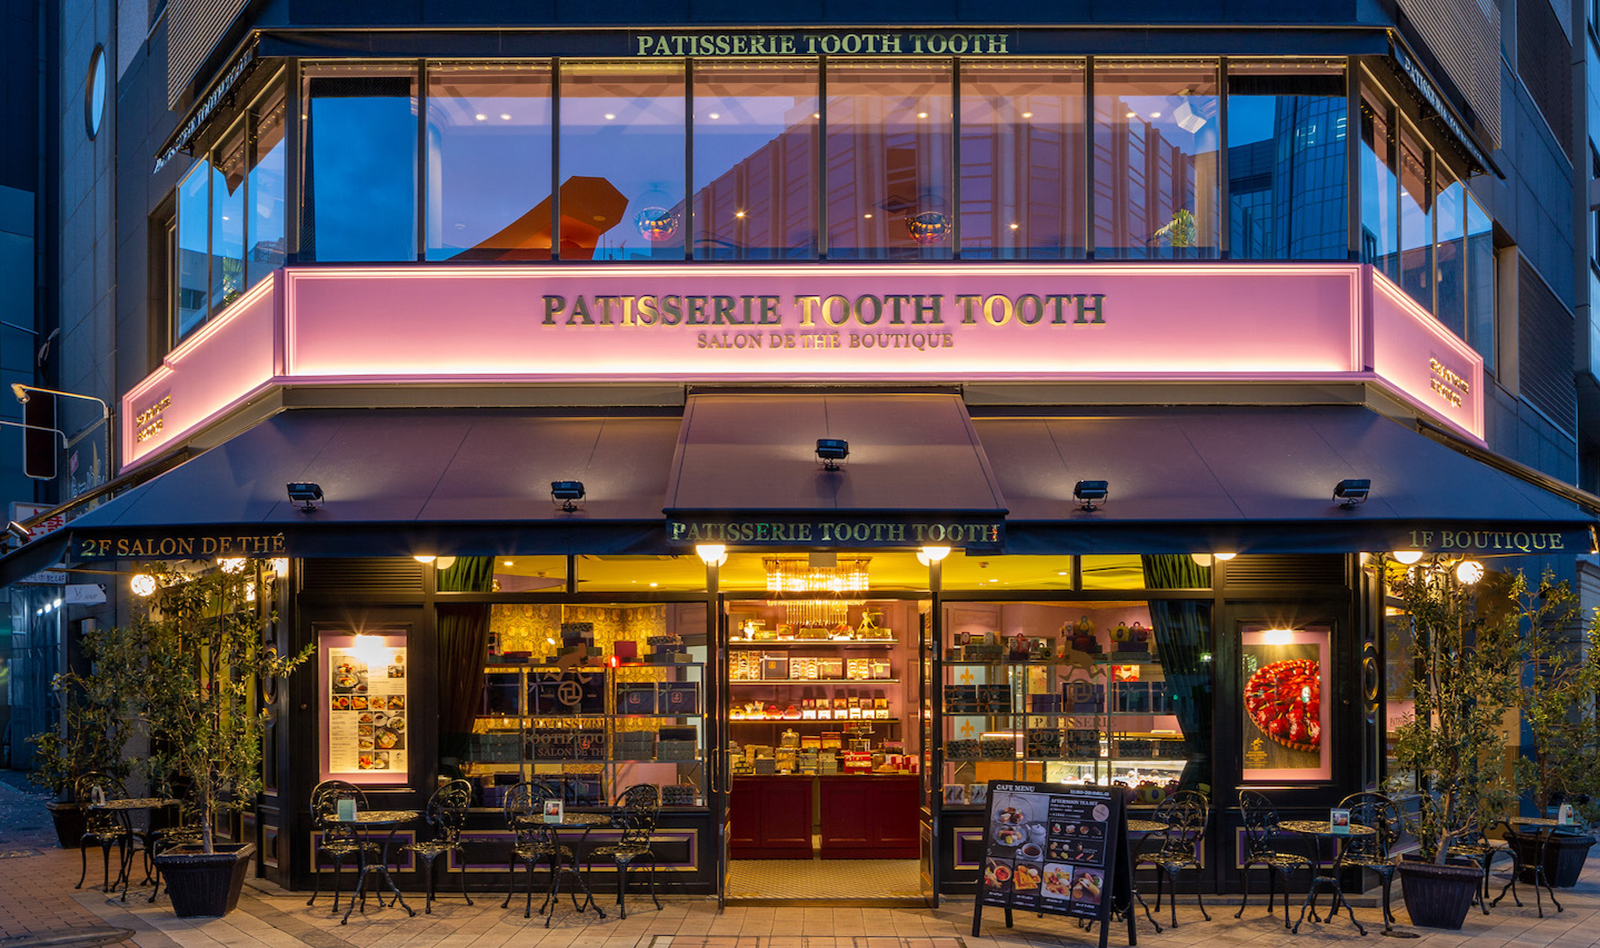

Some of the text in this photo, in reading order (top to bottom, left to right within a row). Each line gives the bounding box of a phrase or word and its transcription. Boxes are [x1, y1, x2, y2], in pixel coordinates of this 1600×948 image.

[637, 33, 1009, 56] PATISSERIE TOOTH TOOTH
[541, 293, 1106, 327] PATISSERIE TOOTH TOOTH
[697, 331, 954, 351] SALON DE THÉ BOUTIQUE
[671, 522, 1000, 542] PATISSERIE TOOTH TOOTH
[1408, 530, 1565, 552] 1F BOUTIQUE
[80, 532, 286, 557] 2F SALON DE THÉ
[533, 718, 614, 729] PATISSERI
[1034, 716, 1118, 728] PATISSERIE
[521, 733, 573, 745] TOOTH
[537, 747, 572, 757] SALON
[574, 748, 589, 757] DE
